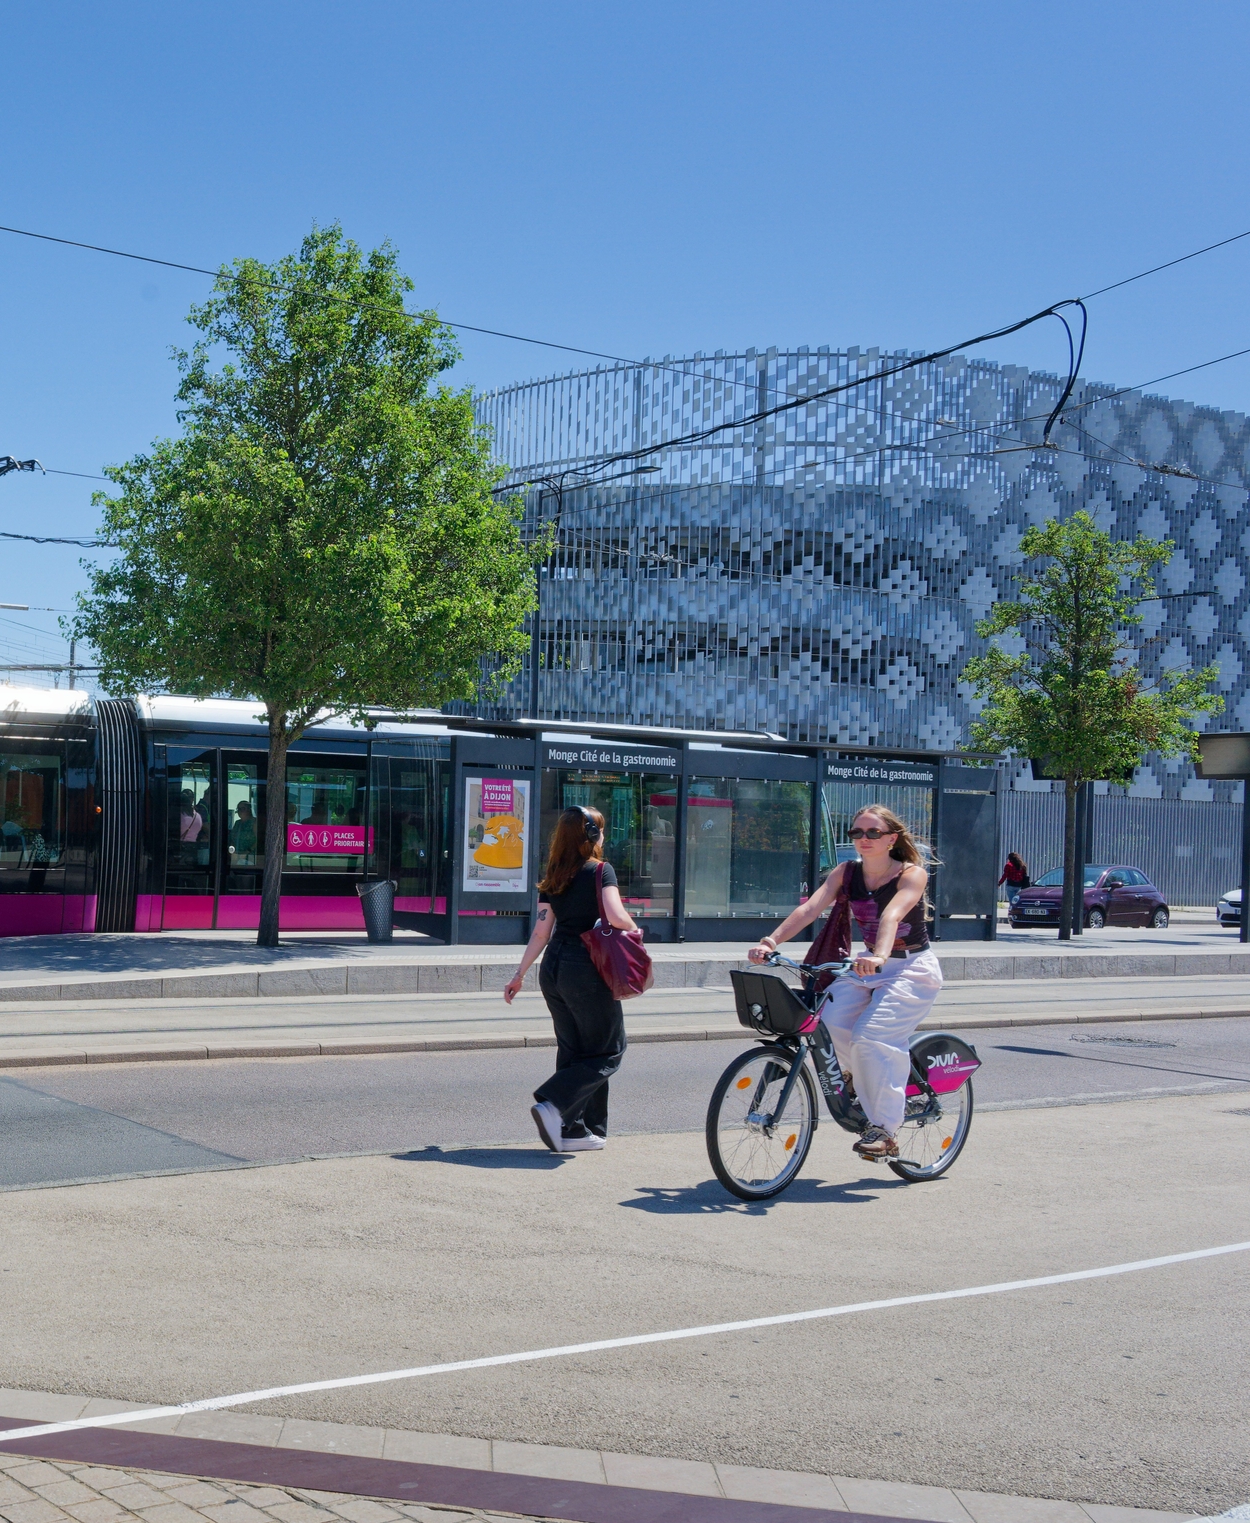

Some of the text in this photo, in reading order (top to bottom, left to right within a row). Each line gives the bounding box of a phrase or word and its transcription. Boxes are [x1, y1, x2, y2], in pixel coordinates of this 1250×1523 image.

[548, 748, 676, 767] Monge Cité de la gastronomie
[827, 764, 934, 782] Monge Cité de la gastronomie
[484, 791, 489, 800] À
[926, 1051, 962, 1070] DIVIA
[943, 1064, 960, 1074] vélodi
[820, 1043, 845, 1098] DIVIA
[818, 1070, 833, 1096] vélodi
